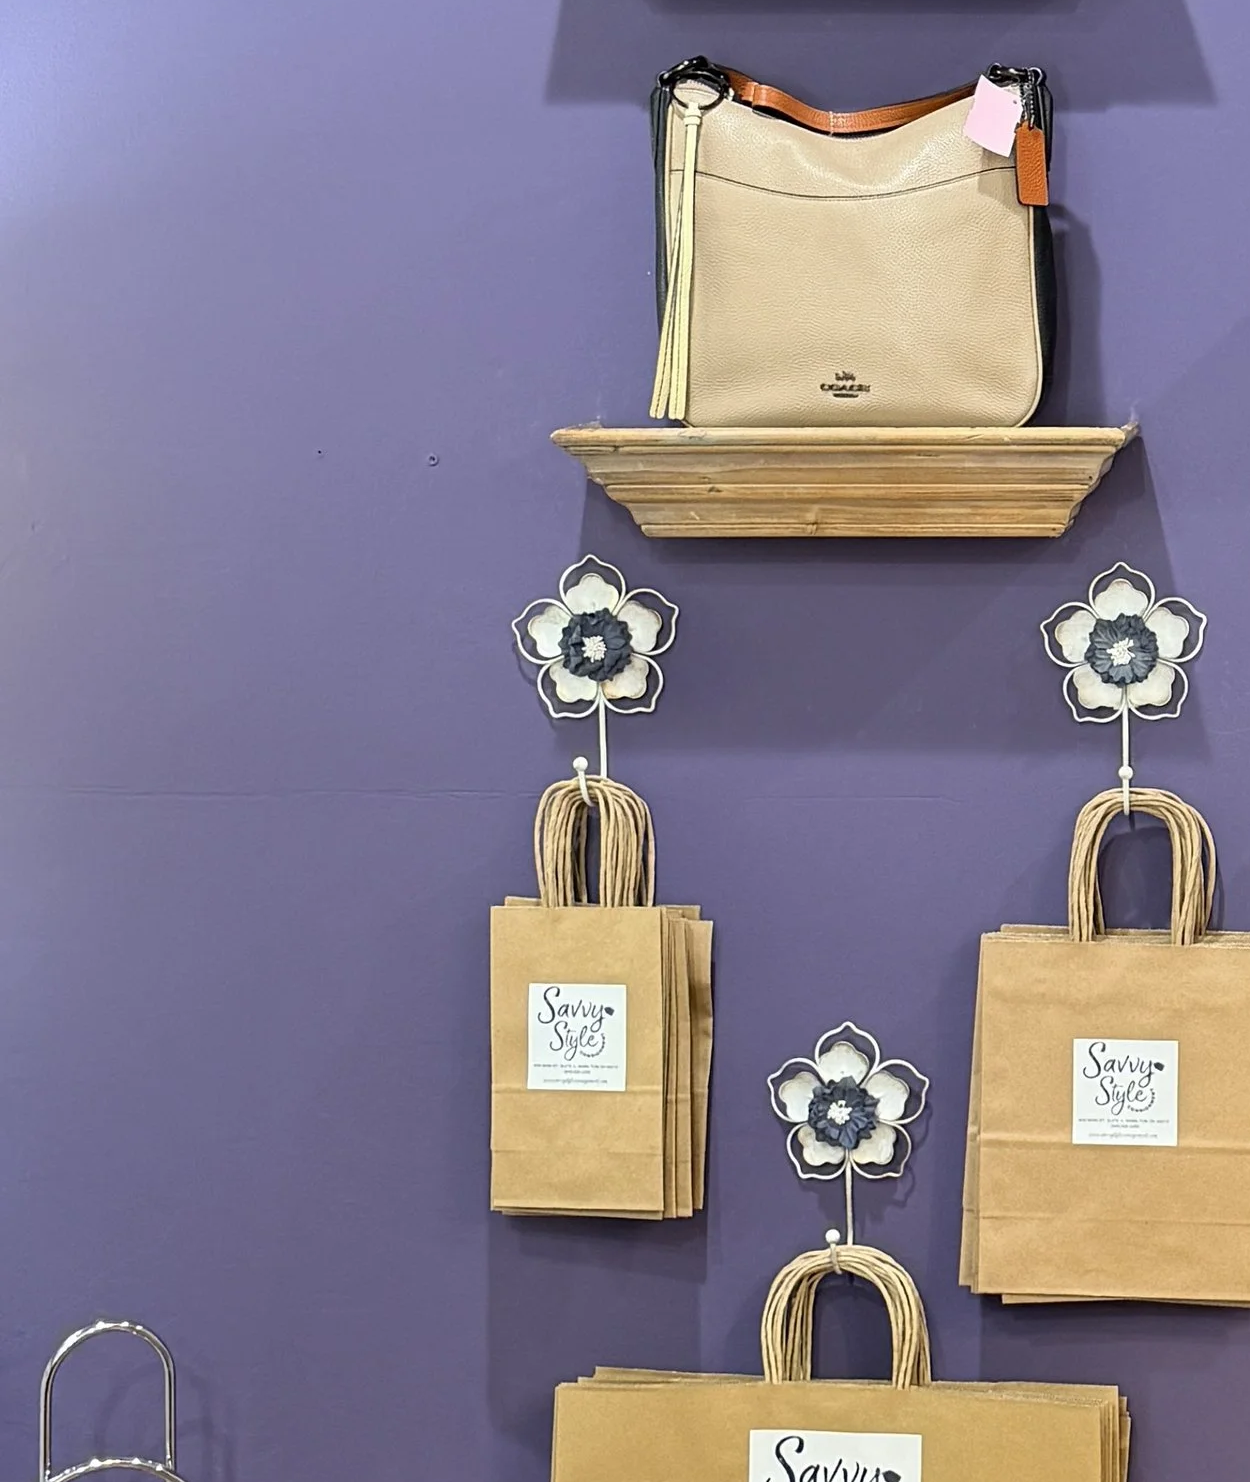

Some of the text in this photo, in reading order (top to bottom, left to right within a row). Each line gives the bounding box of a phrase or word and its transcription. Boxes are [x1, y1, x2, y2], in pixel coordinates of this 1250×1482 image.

[537, 986, 605, 1033] Savvy
[549, 1020, 599, 1061] Style
[1083, 1041, 1154, 1088] Savvy
[1095, 1075, 1147, 1115] Style
